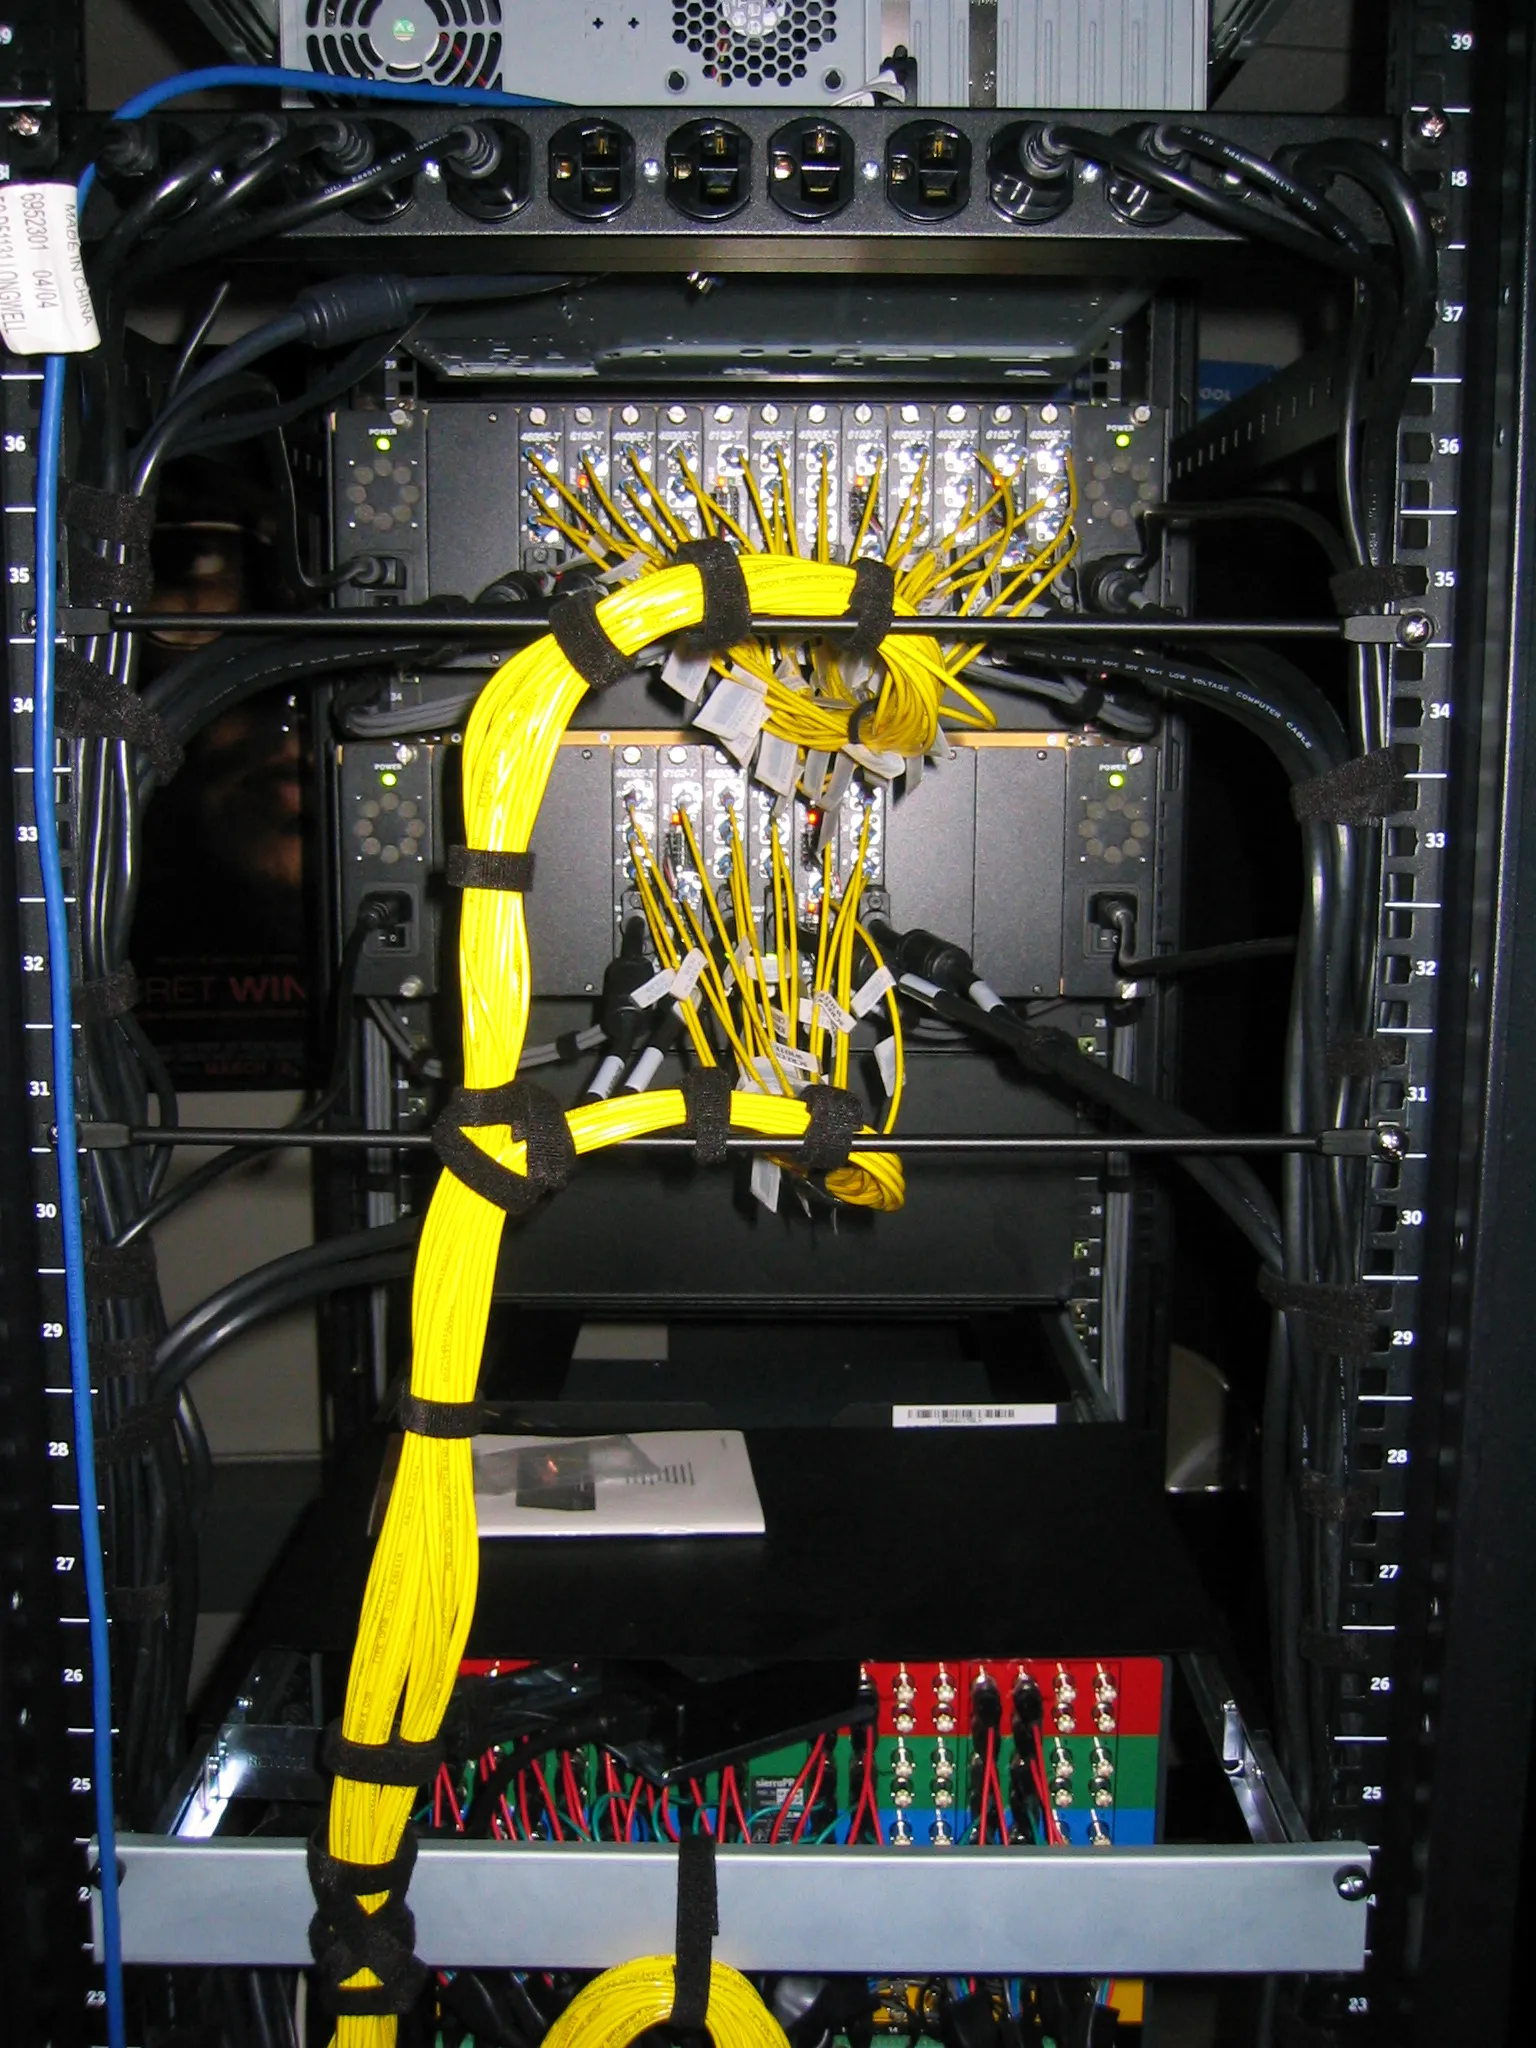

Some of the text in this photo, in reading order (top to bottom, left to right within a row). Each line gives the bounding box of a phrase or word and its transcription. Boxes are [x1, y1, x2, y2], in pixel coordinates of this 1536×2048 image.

[0, 28, 12, 45] 9
[1451, 33, 1473, 50] 39
[20, 192, 60, 309] 6952301 04/04
[66, 203, 94, 327] MADE IN CHINA
[1442, 305, 1464, 322] 37
[368, 428, 398, 436] POWER
[4, 435, 26, 452] 36
[1438, 438, 1460, 455] 36
[9, 567, 30, 584] 35
[1434, 571, 1455, 587] 35
[13, 697, 34, 714] 34
[1191, 677, 1231, 693] VOLTAGE
[1235, 690, 1282, 719] COMPUTER
[1285, 720, 1313, 750] CABLE
[1429, 702, 1450, 719] 34
[374, 763, 403, 771] POWER
[1098, 763, 1127, 771] POWER
[17, 826, 38, 842] 33
[1425, 832, 1445, 849] 33
[23, 955, 44, 972] 32
[1415, 960, 1436, 976] 32
[29, 1080, 51, 1097] 31
[1407, 1086, 1428, 1102] 31
[36, 1203, 57, 1219] 30
[1401, 1210, 1423, 1225] 30
[43, 1322, 64, 1338] 29
[1392, 1330, 1414, 1346] 29
[48, 1441, 69, 1457] 28
[1387, 1449, 1408, 1464] 28
[56, 1556, 75, 1571] 27
[1379, 1564, 1399, 1579] 27
[64, 1668, 84, 1683] 26
[1370, 1676, 1390, 1691] 26
[72, 1777, 92, 1791] 25
[1362, 1786, 1382, 1800] 25
[87, 1990, 106, 2005] 23
